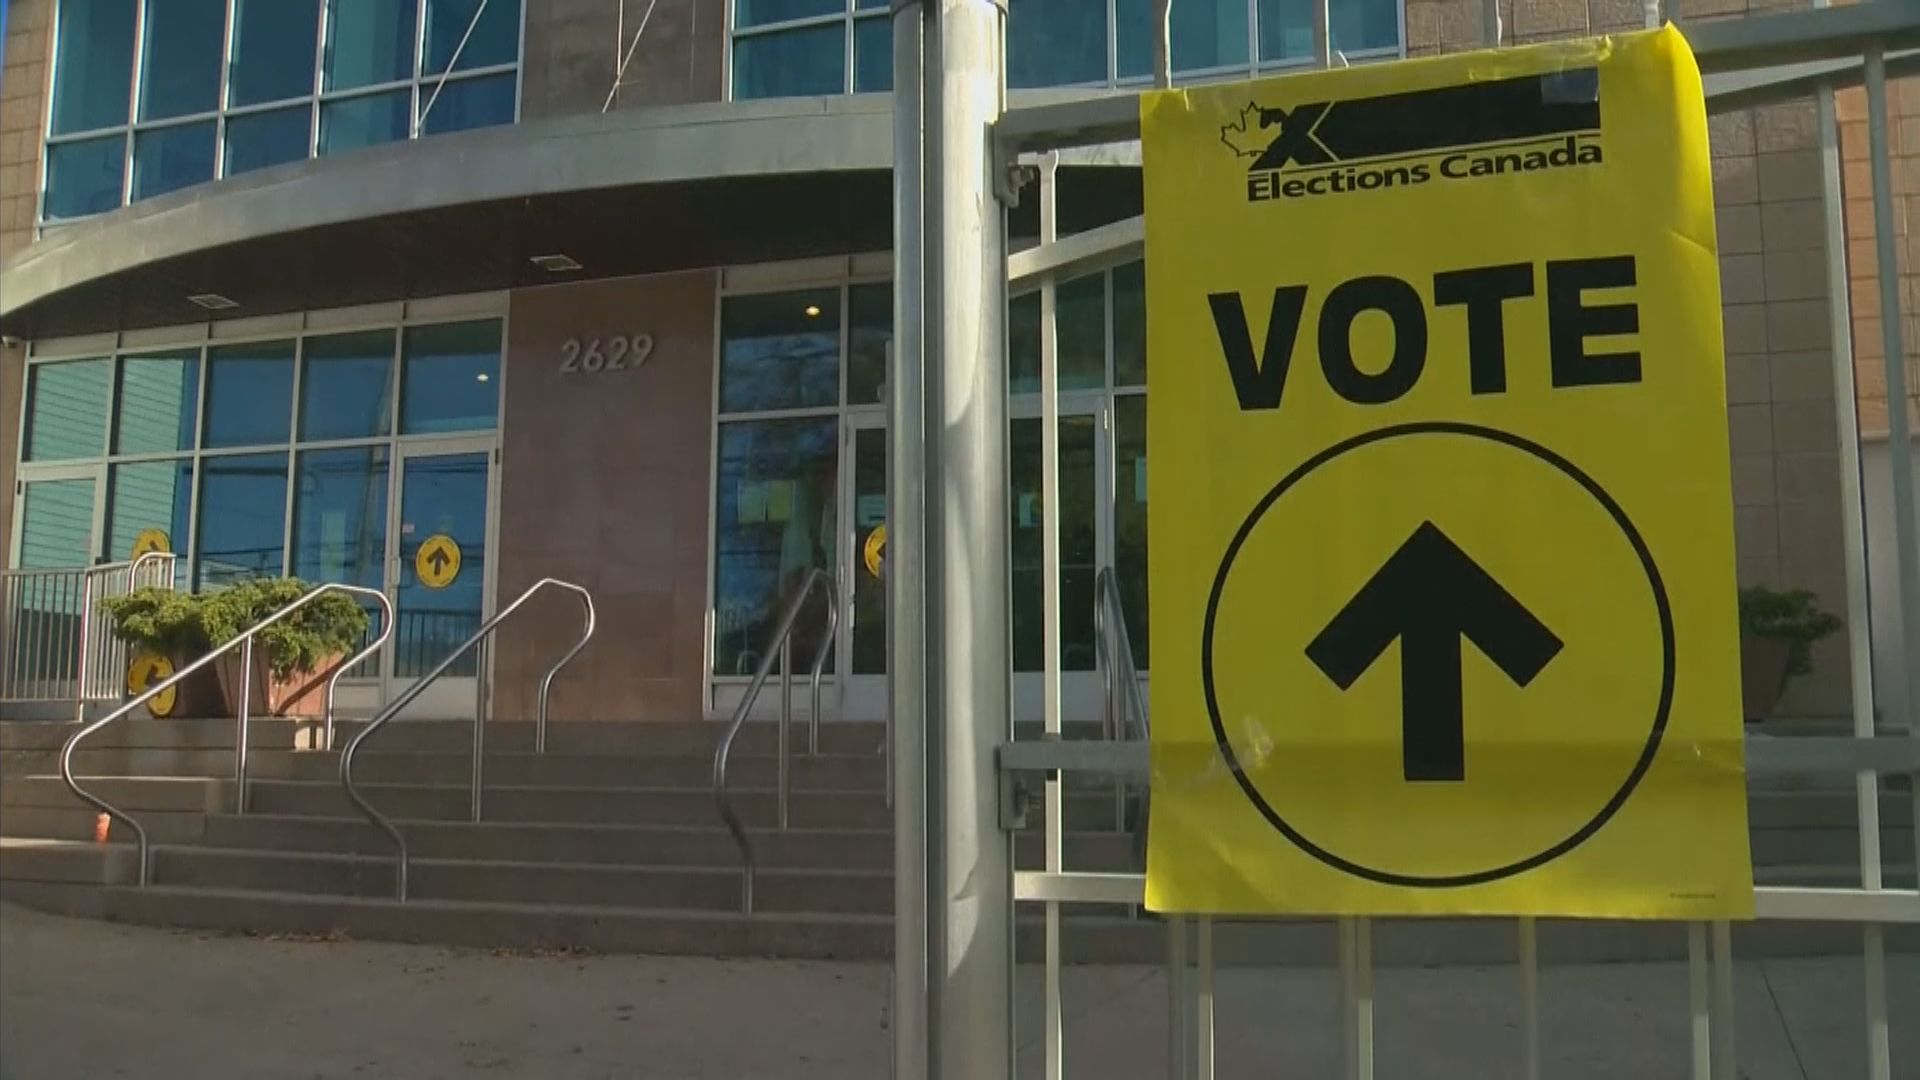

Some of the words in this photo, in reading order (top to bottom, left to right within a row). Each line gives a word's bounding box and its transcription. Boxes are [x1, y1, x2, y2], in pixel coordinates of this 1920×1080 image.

[1247, 163, 1430, 201] Elections
[1440, 137, 1602, 178] Canada
[559, 333, 656, 374] 2629
[1207, 255, 1642, 411] VOTE
